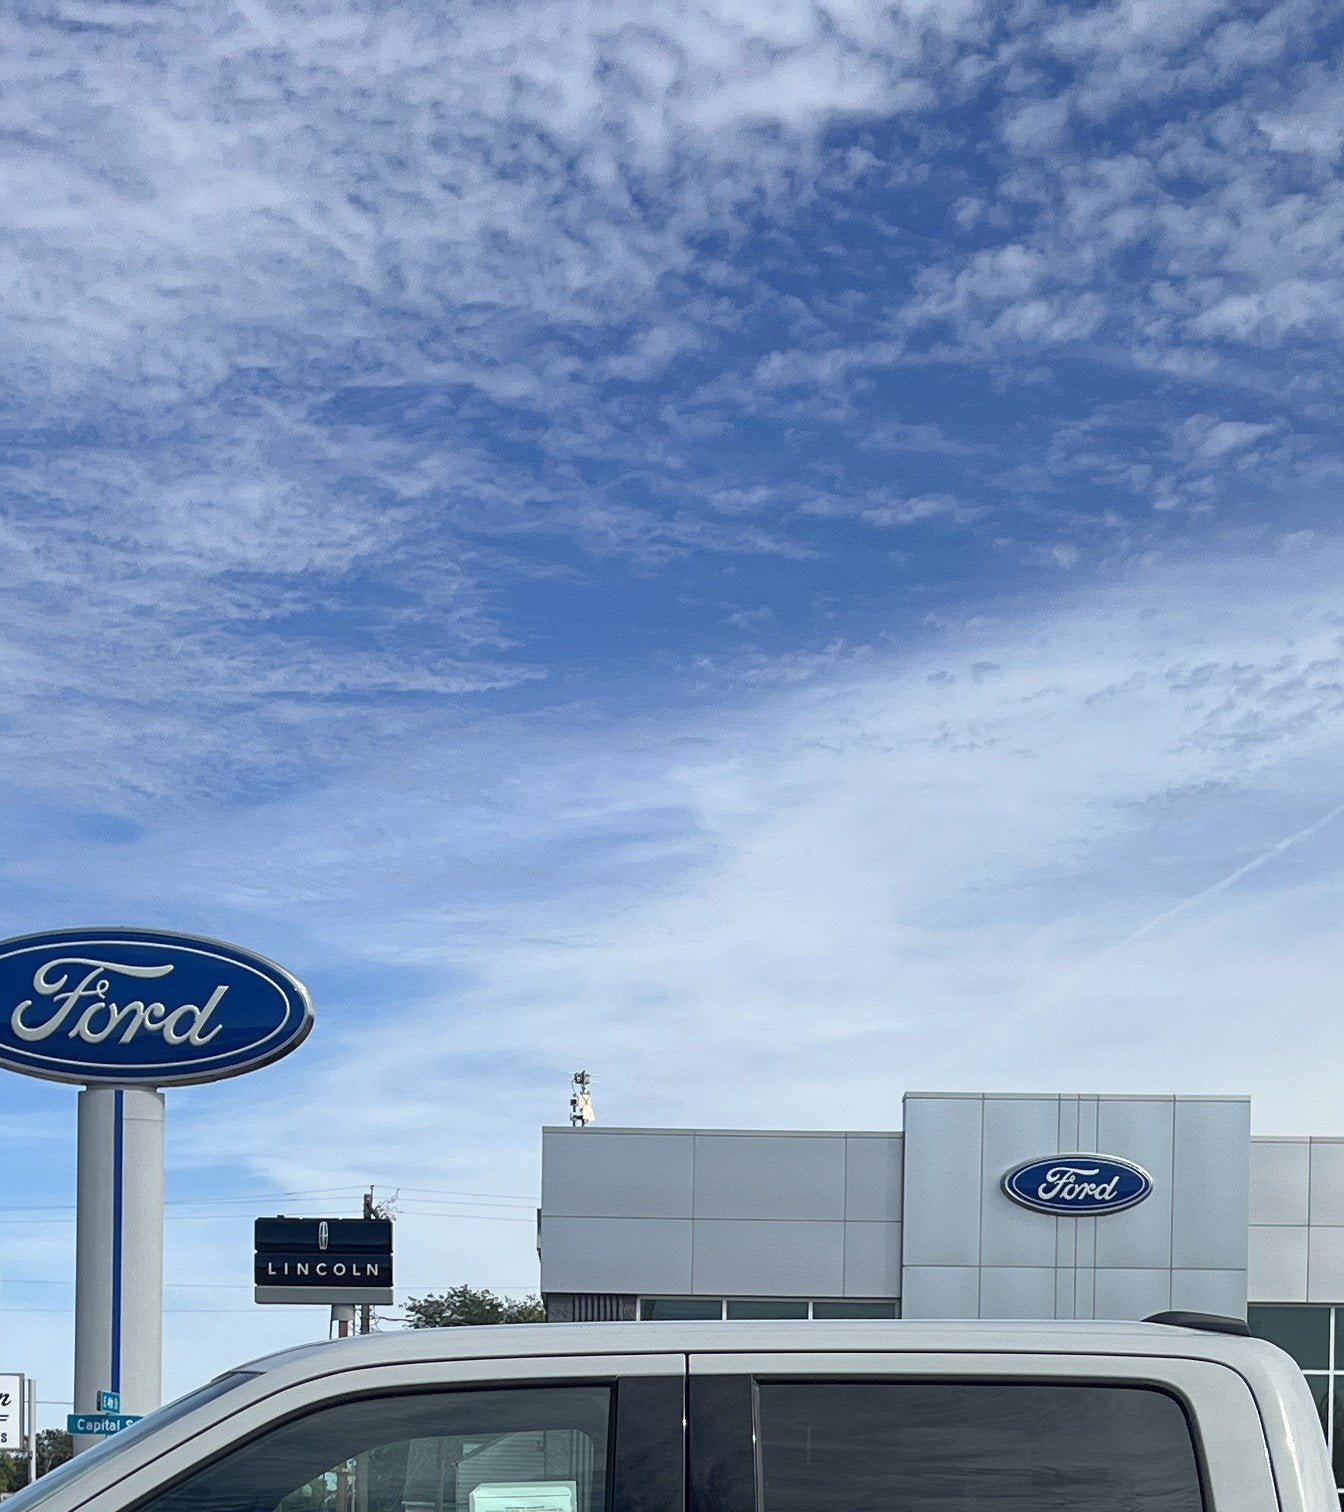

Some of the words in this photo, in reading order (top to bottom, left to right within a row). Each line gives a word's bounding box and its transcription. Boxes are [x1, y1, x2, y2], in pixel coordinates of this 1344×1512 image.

[11, 957, 229, 1047] Ford
[1038, 1166, 1119, 1201] Ford
[268, 1262, 379, 1277] LINCOLN
[77, 1418, 121, 1433] Capital
